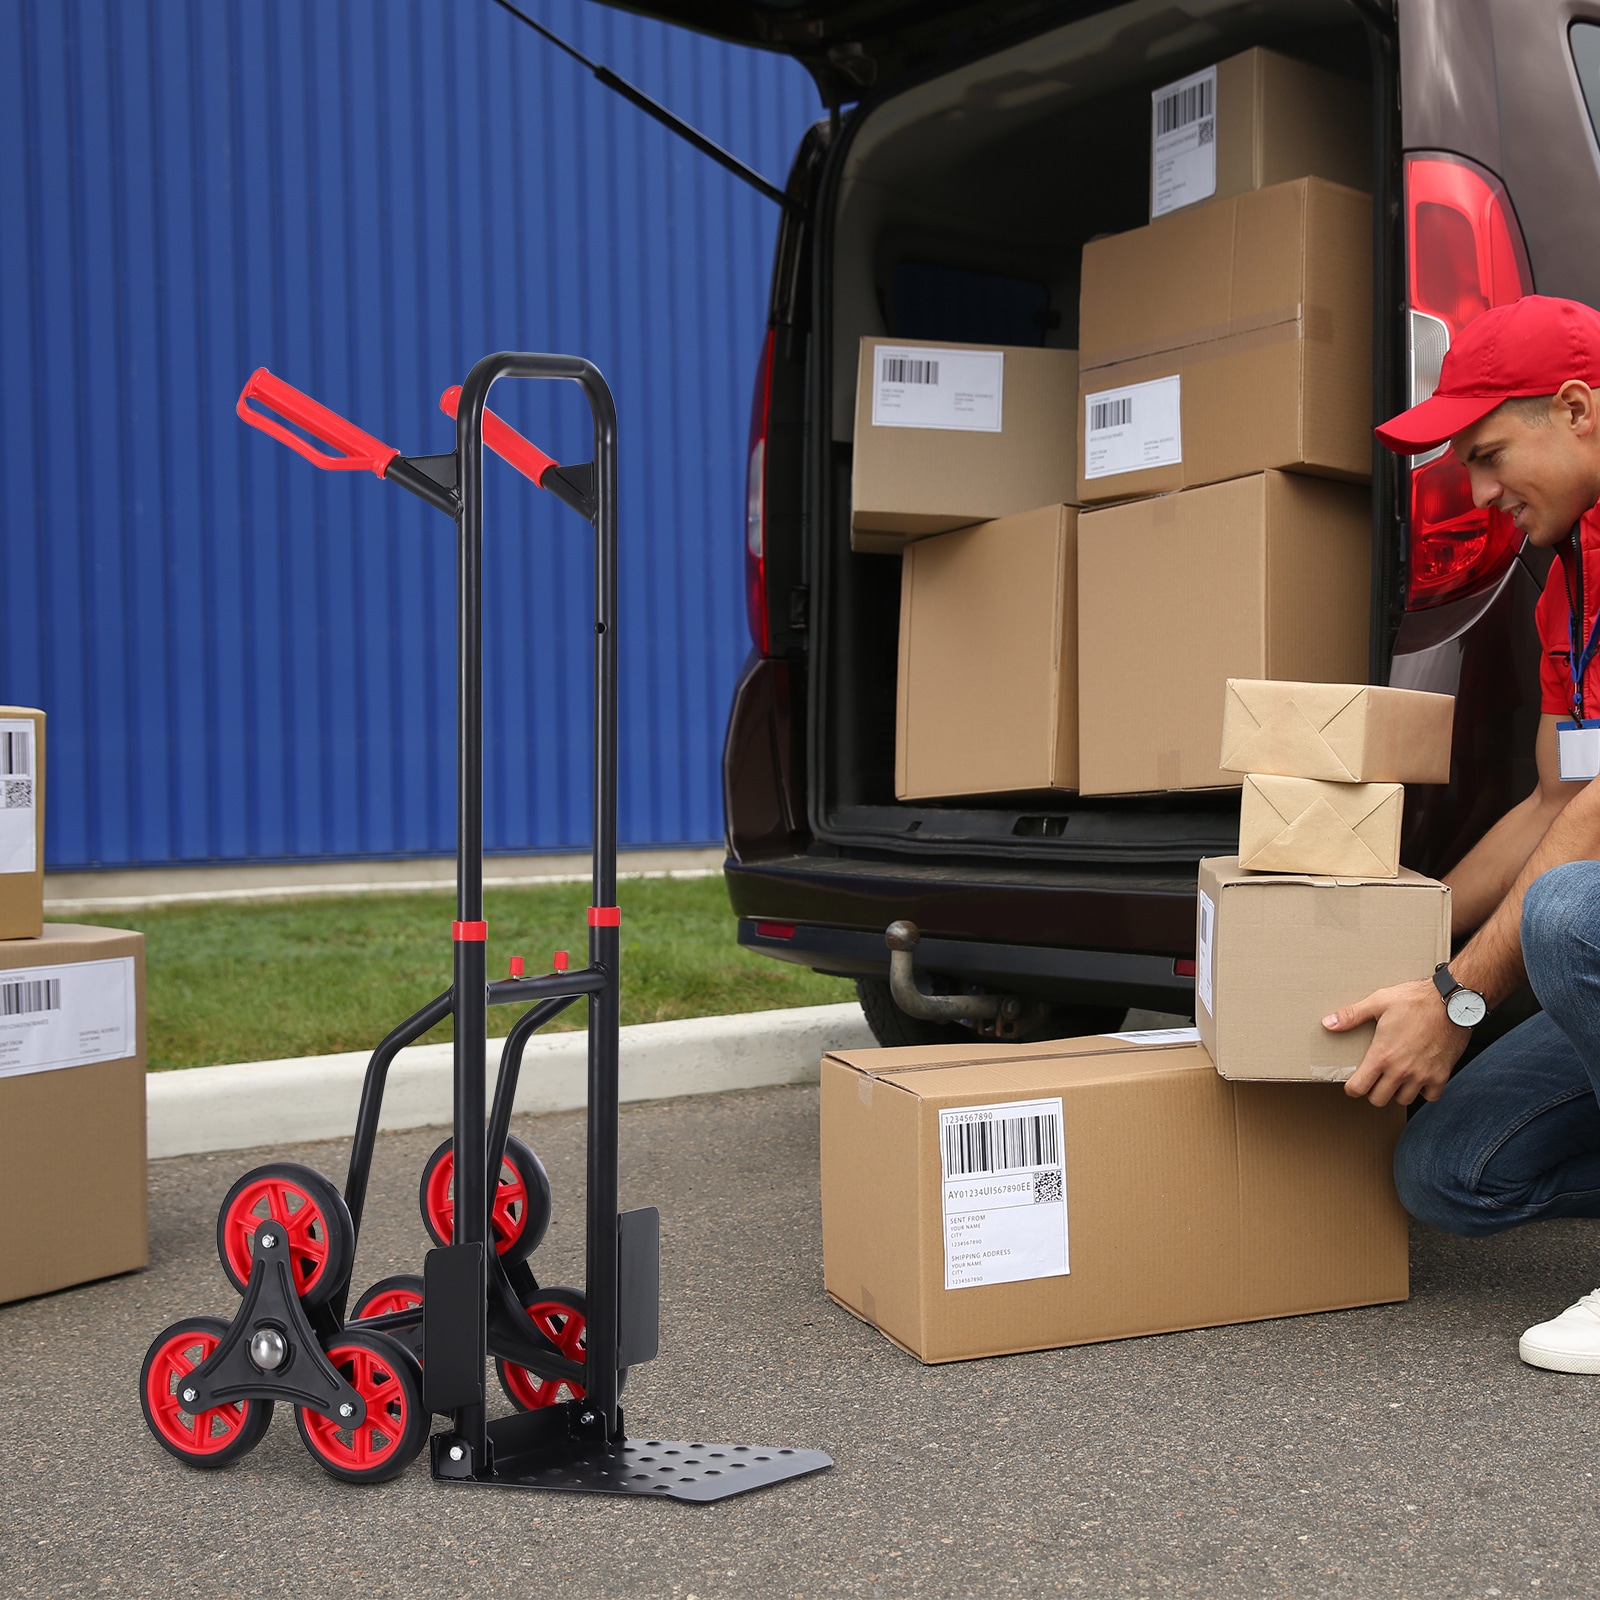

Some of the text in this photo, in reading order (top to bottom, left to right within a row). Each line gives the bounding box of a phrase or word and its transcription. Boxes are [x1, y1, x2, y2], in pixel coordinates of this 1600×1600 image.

[945, 1112, 993, 1124] 1234567890
[950, 1214, 986, 1225] SENT FROM
[951, 1239, 983, 1247] 1234567890
[951, 1248, 1011, 1262] SHIPPING ADDRESS
